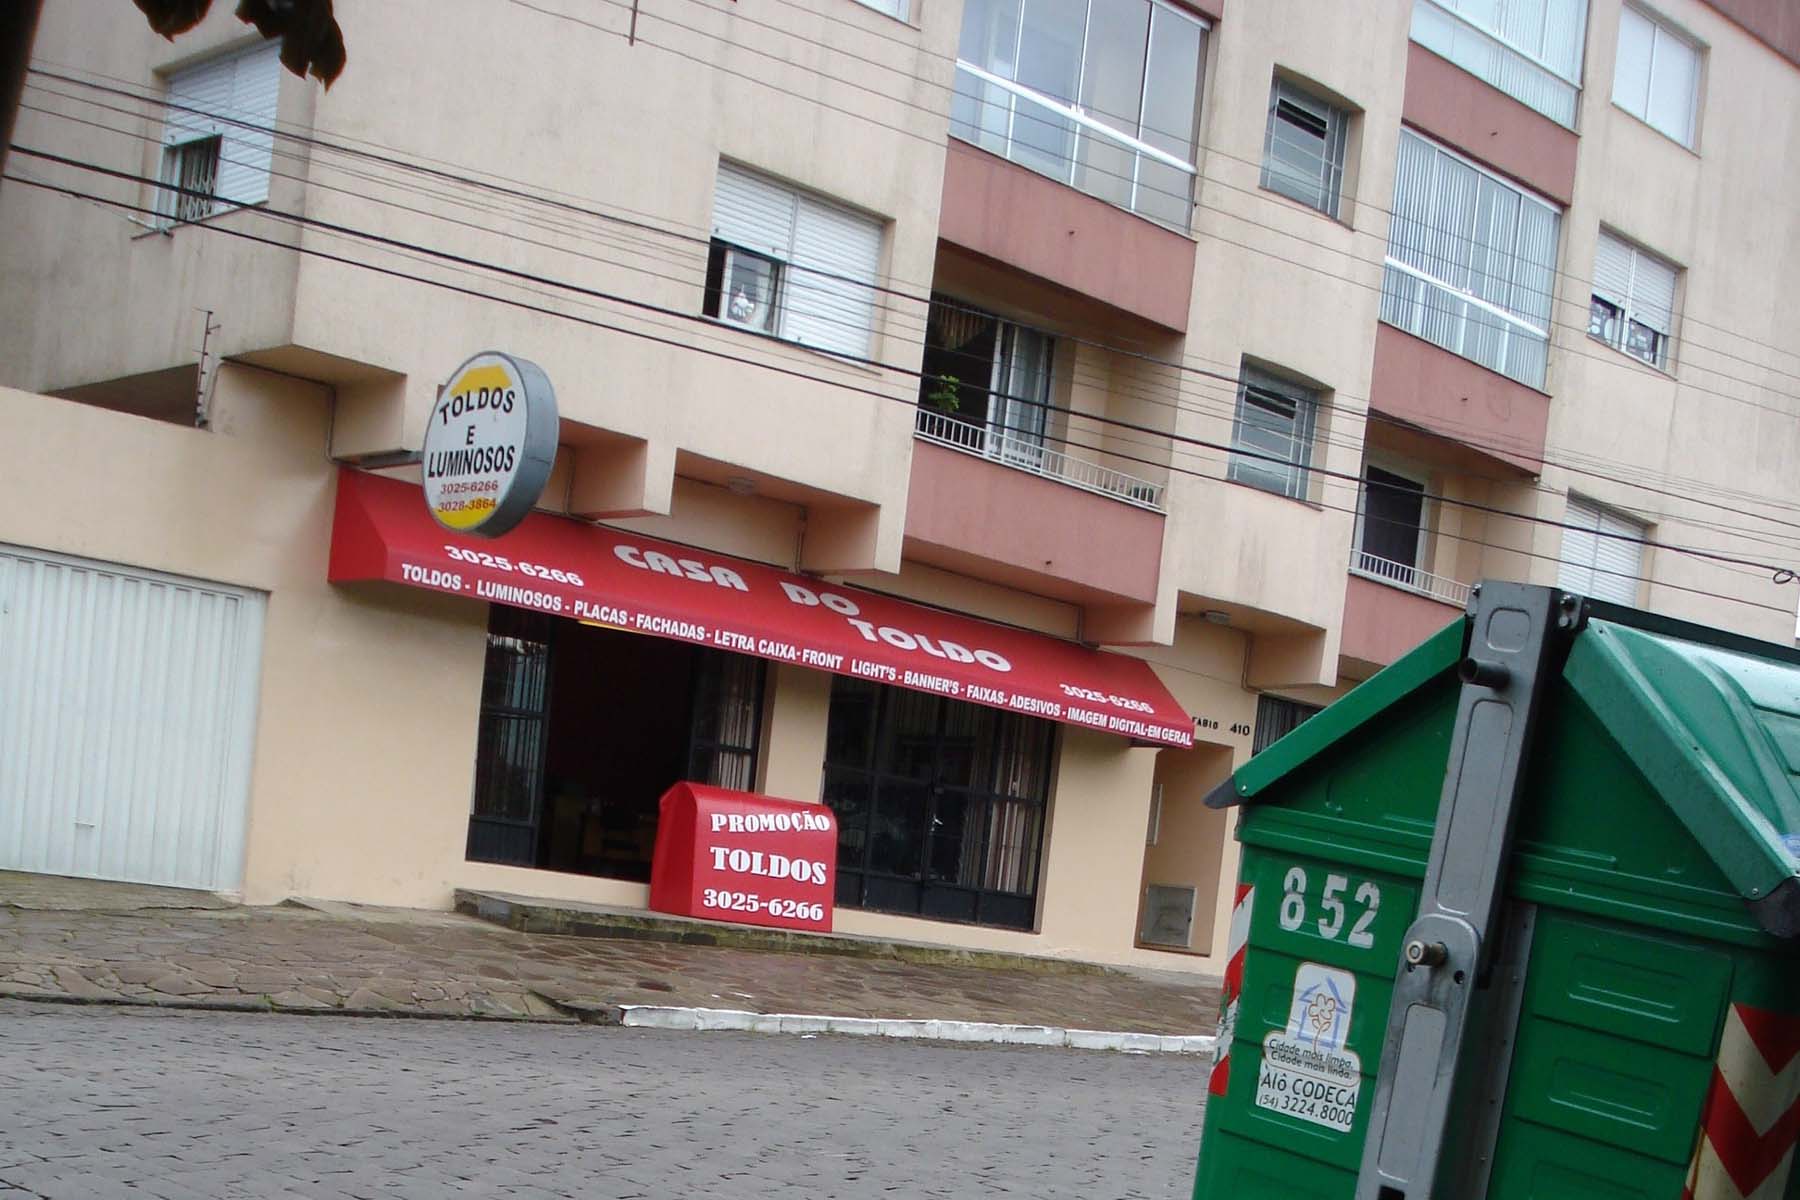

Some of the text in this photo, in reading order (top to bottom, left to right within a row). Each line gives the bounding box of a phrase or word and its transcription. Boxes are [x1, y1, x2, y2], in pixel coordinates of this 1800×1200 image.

[439, 386, 515, 425] TOLDOS
[465, 425, 476, 445] E
[428, 445, 515, 478] LUMINOSOS
[440, 480, 499, 494] 3025-6266
[444, 545, 585, 587] 3025-6266
[613, 544, 860, 616] CASA DO
[402, 563, 462, 591] TOLDOS
[476, 579, 562, 612] LUMINOSOS
[574, 600, 628, 626] PLACAS
[636, 613, 705, 641] FACHADAS
[714, 629, 755, 652] LETRA
[851, 658, 897, 681] LIGHT'S
[904, 670, 959, 695] BANNER'S
[1009, 694, 1060, 717] ADESIVOS
[1067, 706, 1108, 728] IMAGEM
[1161, 727, 1192, 746] GERAL
[847, 617, 1012, 672] TOLDO
[1229, 723, 1250, 736] 410
[710, 810, 830, 833] PROMOÇÃO
[709, 846, 827, 885] TOLDOS
[703, 888, 824, 921] 3025-6266
[1269, 1038, 1300, 1056] Cidade
[1302, 1048, 1323, 1061] mais
[1271, 1050, 1302, 1067] Cidade
[1304, 1061, 1325, 1073] mais
[1261, 1072, 1355, 1109] Alô CODECA
[1259, 1094, 1353, 1126] (54) 3224.8000
